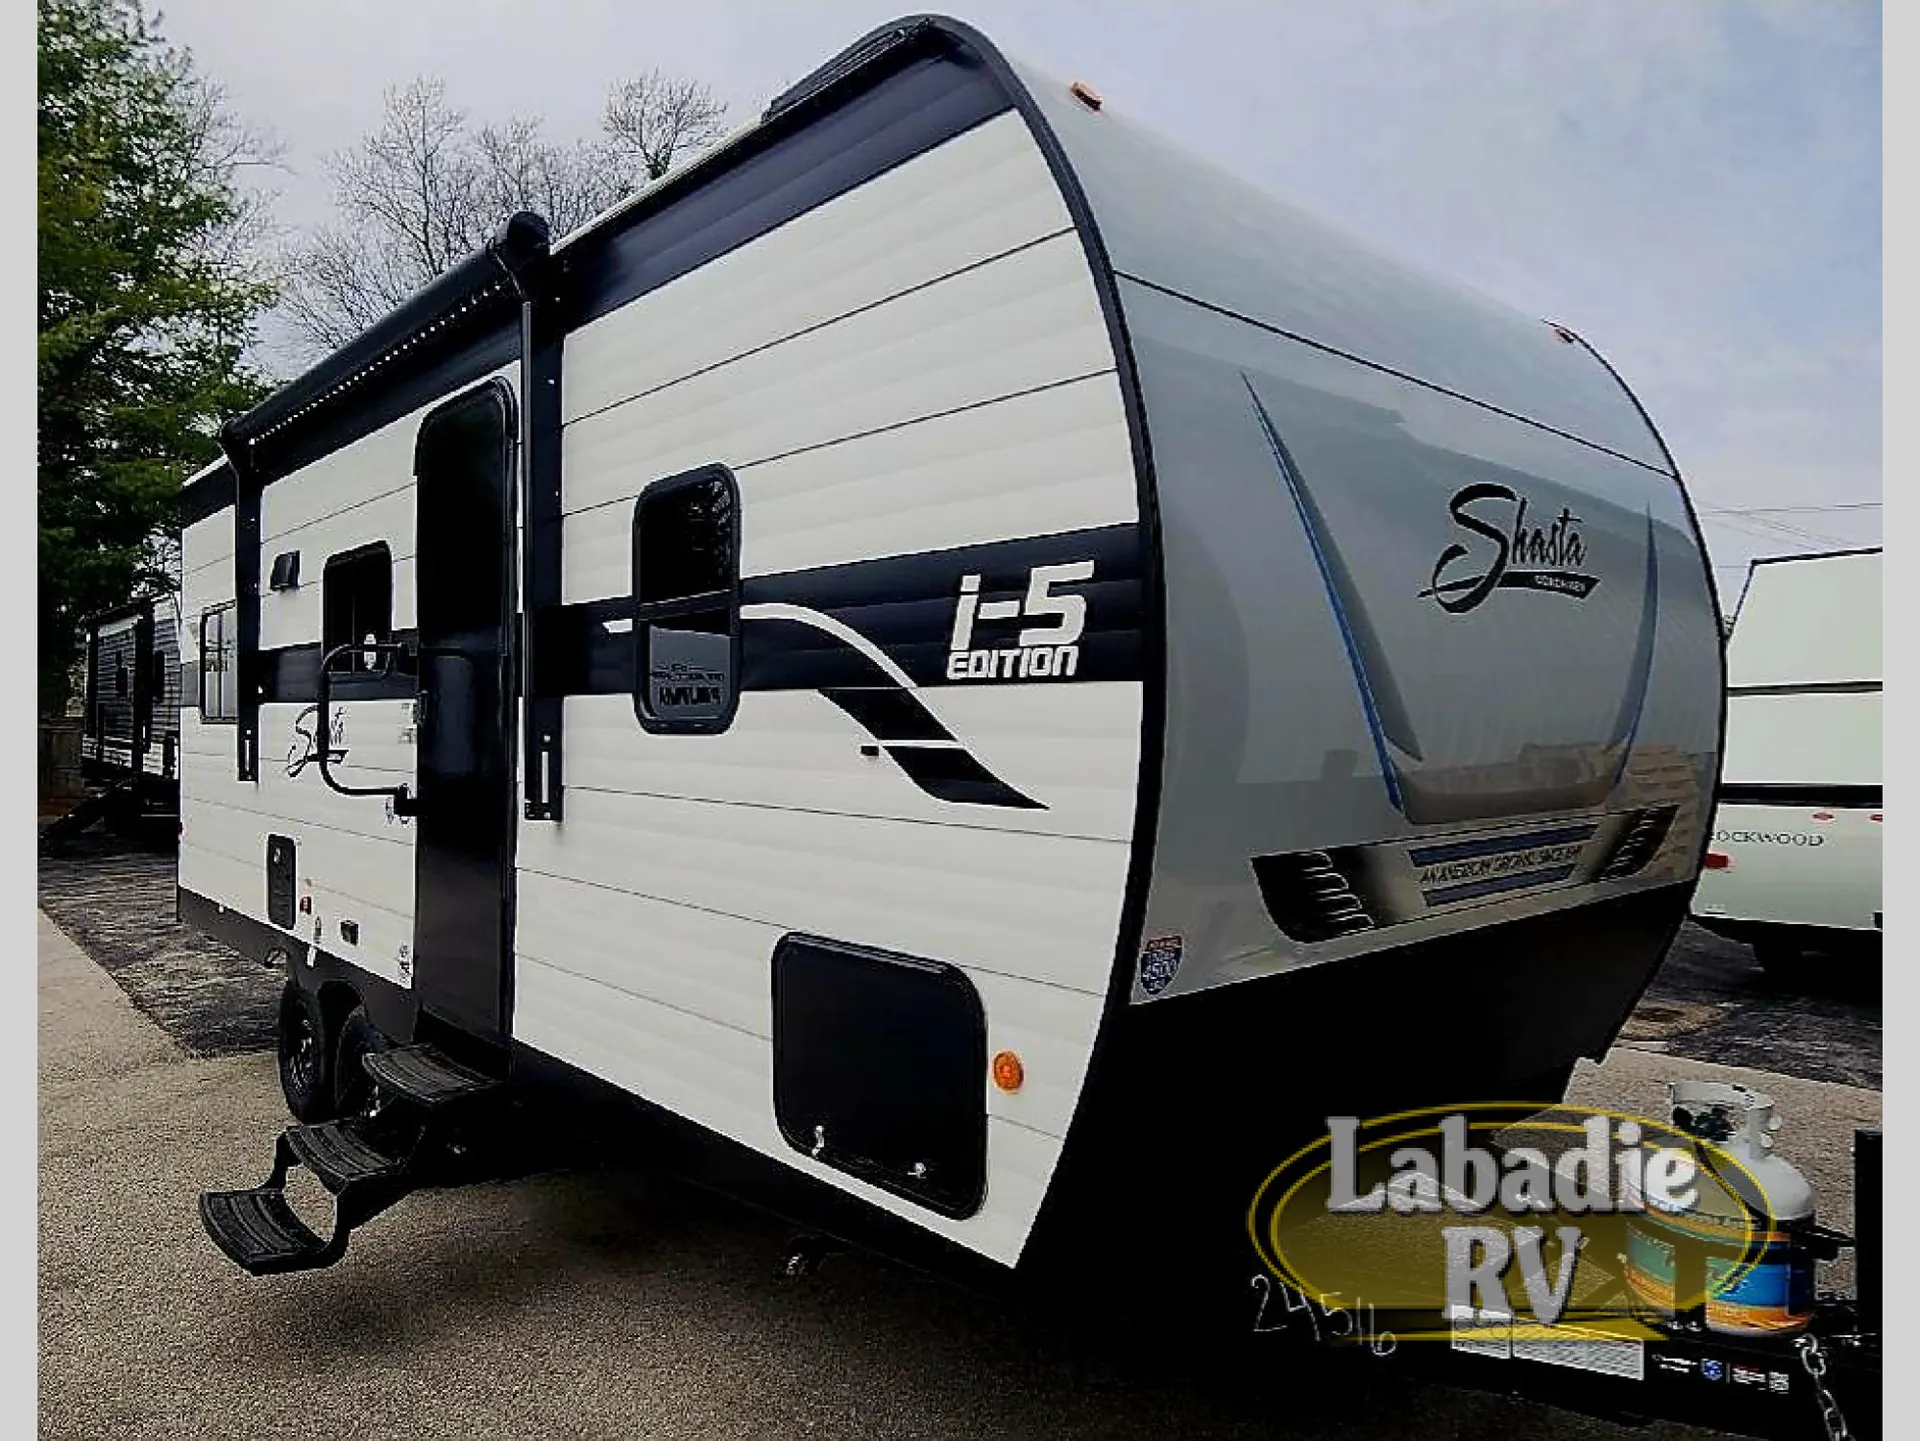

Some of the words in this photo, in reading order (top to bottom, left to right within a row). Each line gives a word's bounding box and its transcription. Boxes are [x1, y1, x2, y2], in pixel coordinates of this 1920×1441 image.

[1418, 483, 1588, 613] Shasta
[951, 560, 1094, 650] i-5
[947, 646, 1079, 679] EDITION
